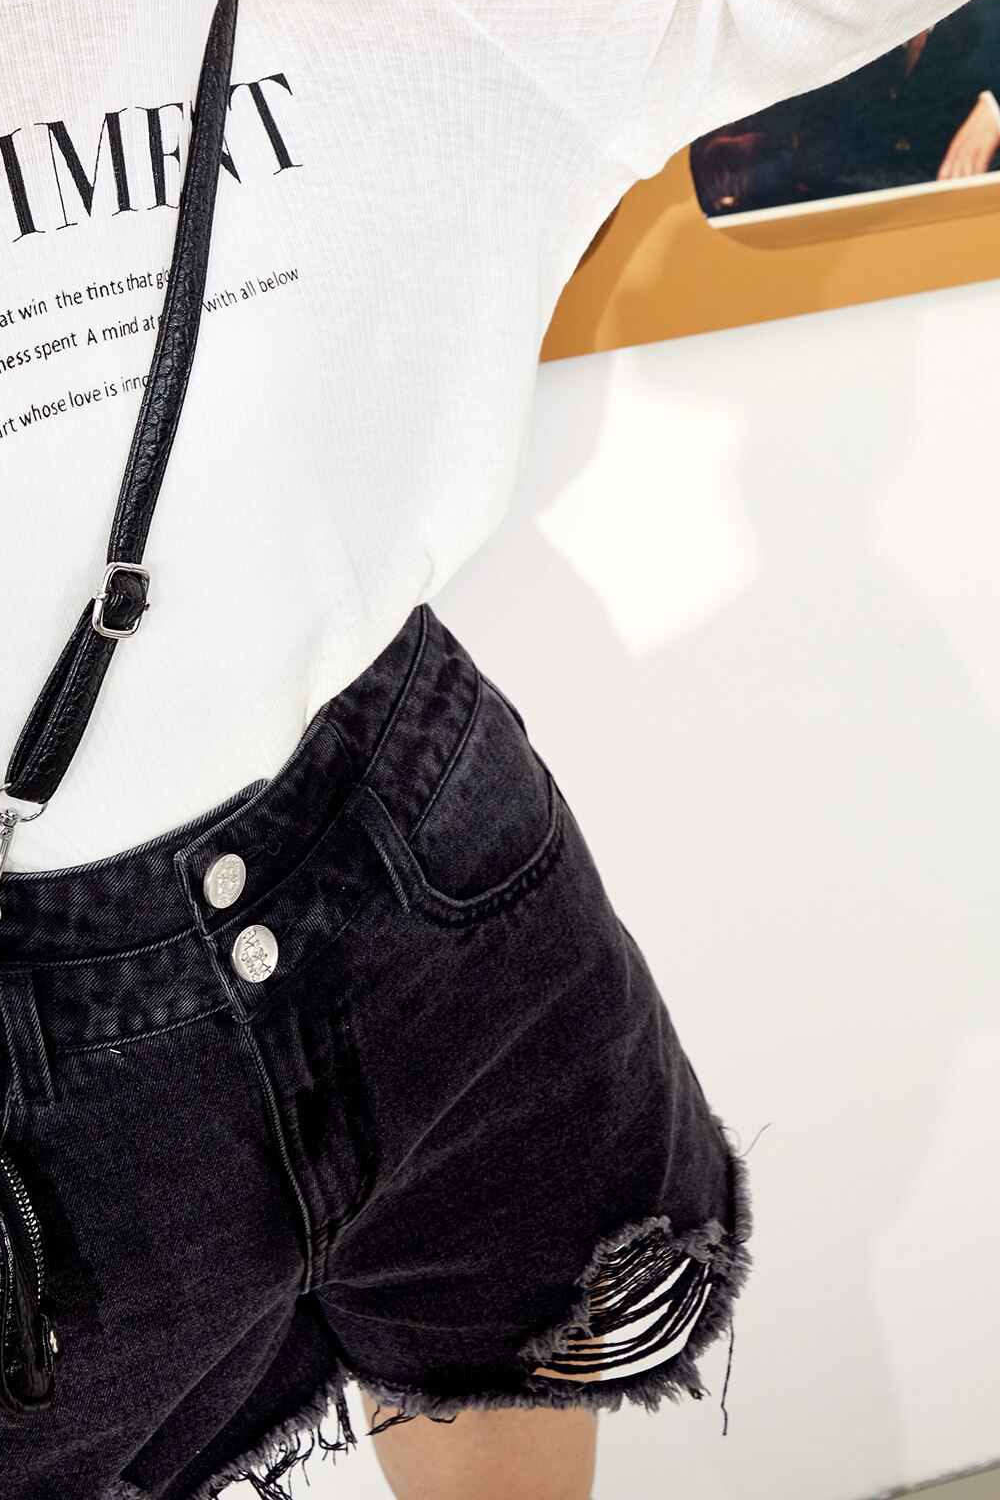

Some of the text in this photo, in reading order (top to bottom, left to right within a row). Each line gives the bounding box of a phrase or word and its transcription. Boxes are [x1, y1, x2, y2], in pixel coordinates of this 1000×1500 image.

[17, 298, 49, 321] win
[54, 289, 83, 311] the
[85, 281, 125, 301] tints
[126, 271, 155, 292] that
[33, 331, 78, 361] spent
[86, 328, 98, 346] A
[101, 315, 139, 342] mind
[142, 314, 156, 332] at
[202, 288, 237, 313] with
[240, 280, 257, 301] all
[258, 267, 300, 294] below
[18, 397, 68, 428] whose
[68, 387, 103, 409] love
[103, 381, 119, 398] is
[120, 374, 151, 394] inno
